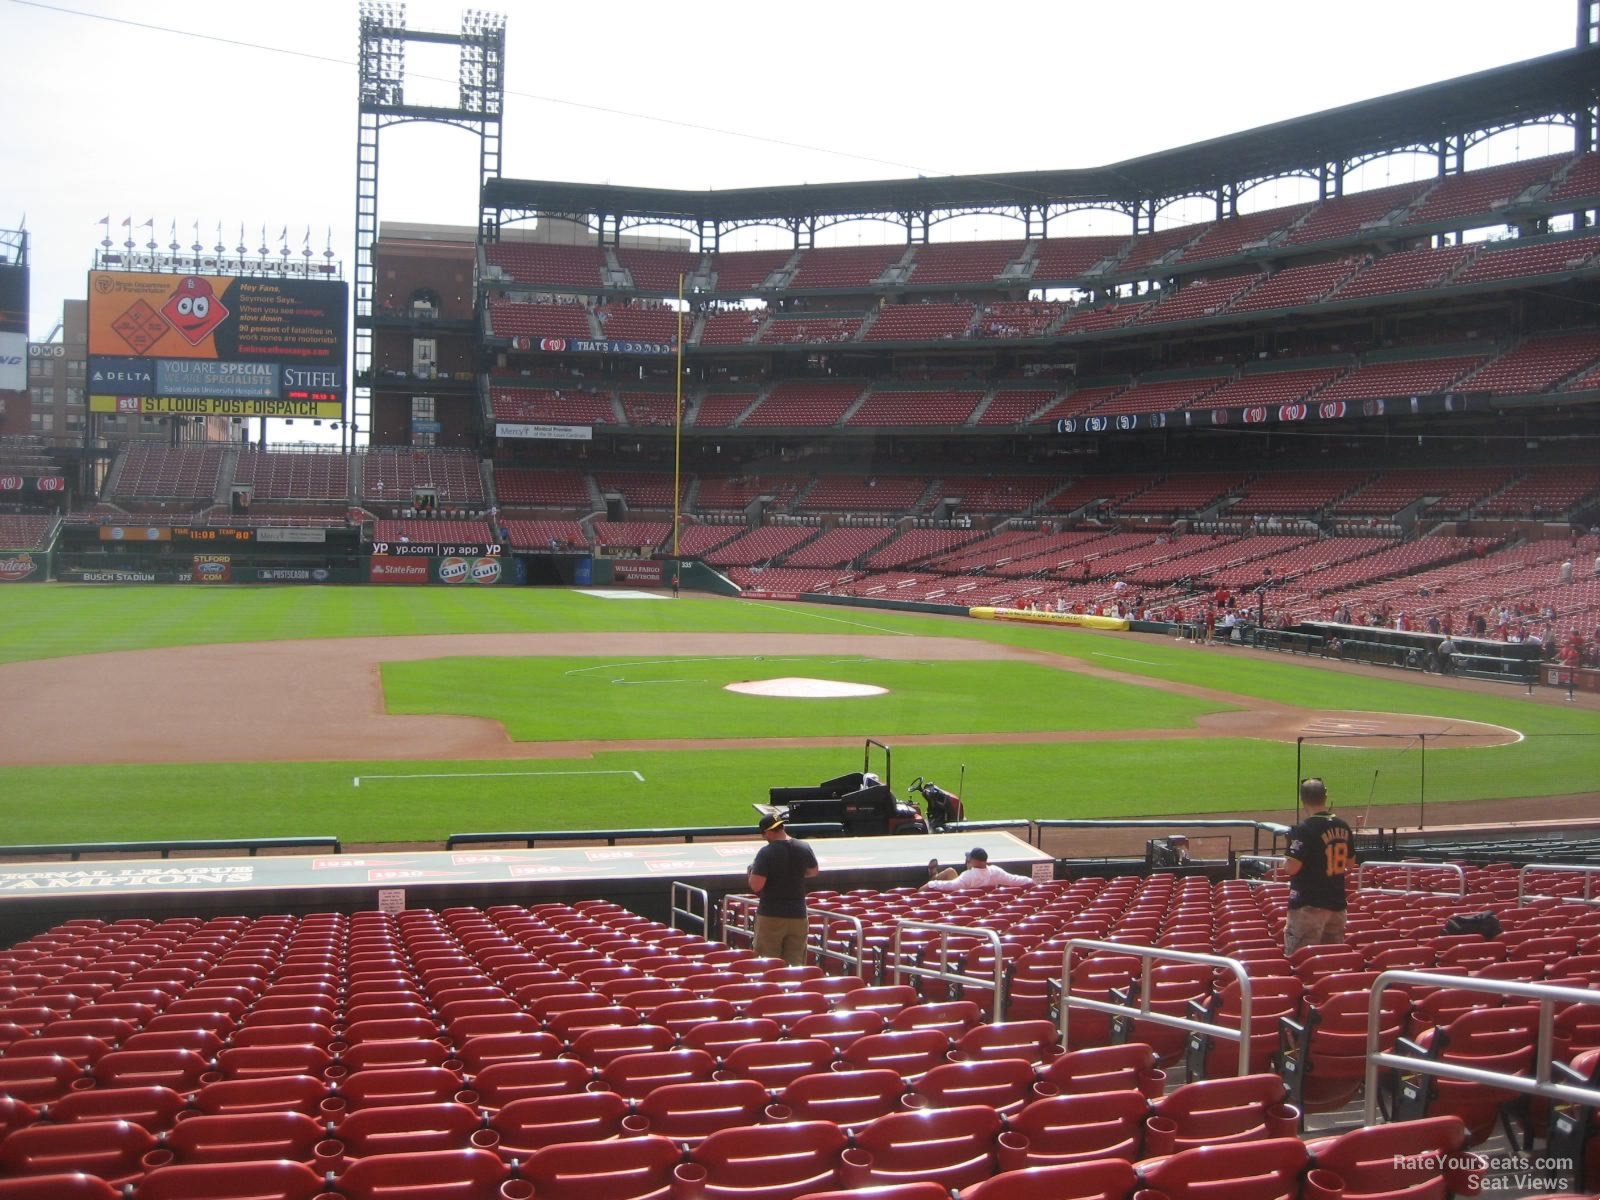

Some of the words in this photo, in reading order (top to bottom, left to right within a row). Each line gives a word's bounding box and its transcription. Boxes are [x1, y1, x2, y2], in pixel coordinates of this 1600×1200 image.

[120, 253, 194, 268] WORLD
[200, 256, 320, 274] CHAMPIONS
[240, 284, 257, 292] Hey
[291, 326, 324, 334] fatalities
[577, 342, 609, 352] THAT'S
[613, 343, 620, 352] A
[164, 361, 189, 373] YOU
[193, 362, 217, 373] ARE
[220, 363, 273, 375] SPECIAL
[107, 371, 151, 381] DELTA
[206, 375, 272, 385] SPECIALISTS
[284, 368, 340, 388] STIFEL
[164, 385, 182, 393] Saint
[201, 386, 235, 396] University
[235, 388, 263, 396] Hospital
[119, 397, 139, 410] stl
[145, 398, 165, 412] ST.
[167, 398, 208, 412] LOUIS
[212, 400, 318, 415] POST-DISPATCH
[191, 531, 216, 539] 11:08
[373, 542, 389, 554] yp
[396, 545, 434, 555] yp.com
[443, 545, 456, 556] yp
[458, 546, 479, 556] app
[486, 544, 501, 555] yp
[273, 570, 310, 579] POSTSEASON
[441, 563, 468, 577] Gulf
[472, 564, 499, 577] Gulf
[615, 565, 637, 573] WELLS
[83, 573, 114, 581] BUSCH
[116, 573, 155, 581] STADIUM
[1325, 842, 1349, 876] 18
[119, 866, 254, 876] LEAGUE
